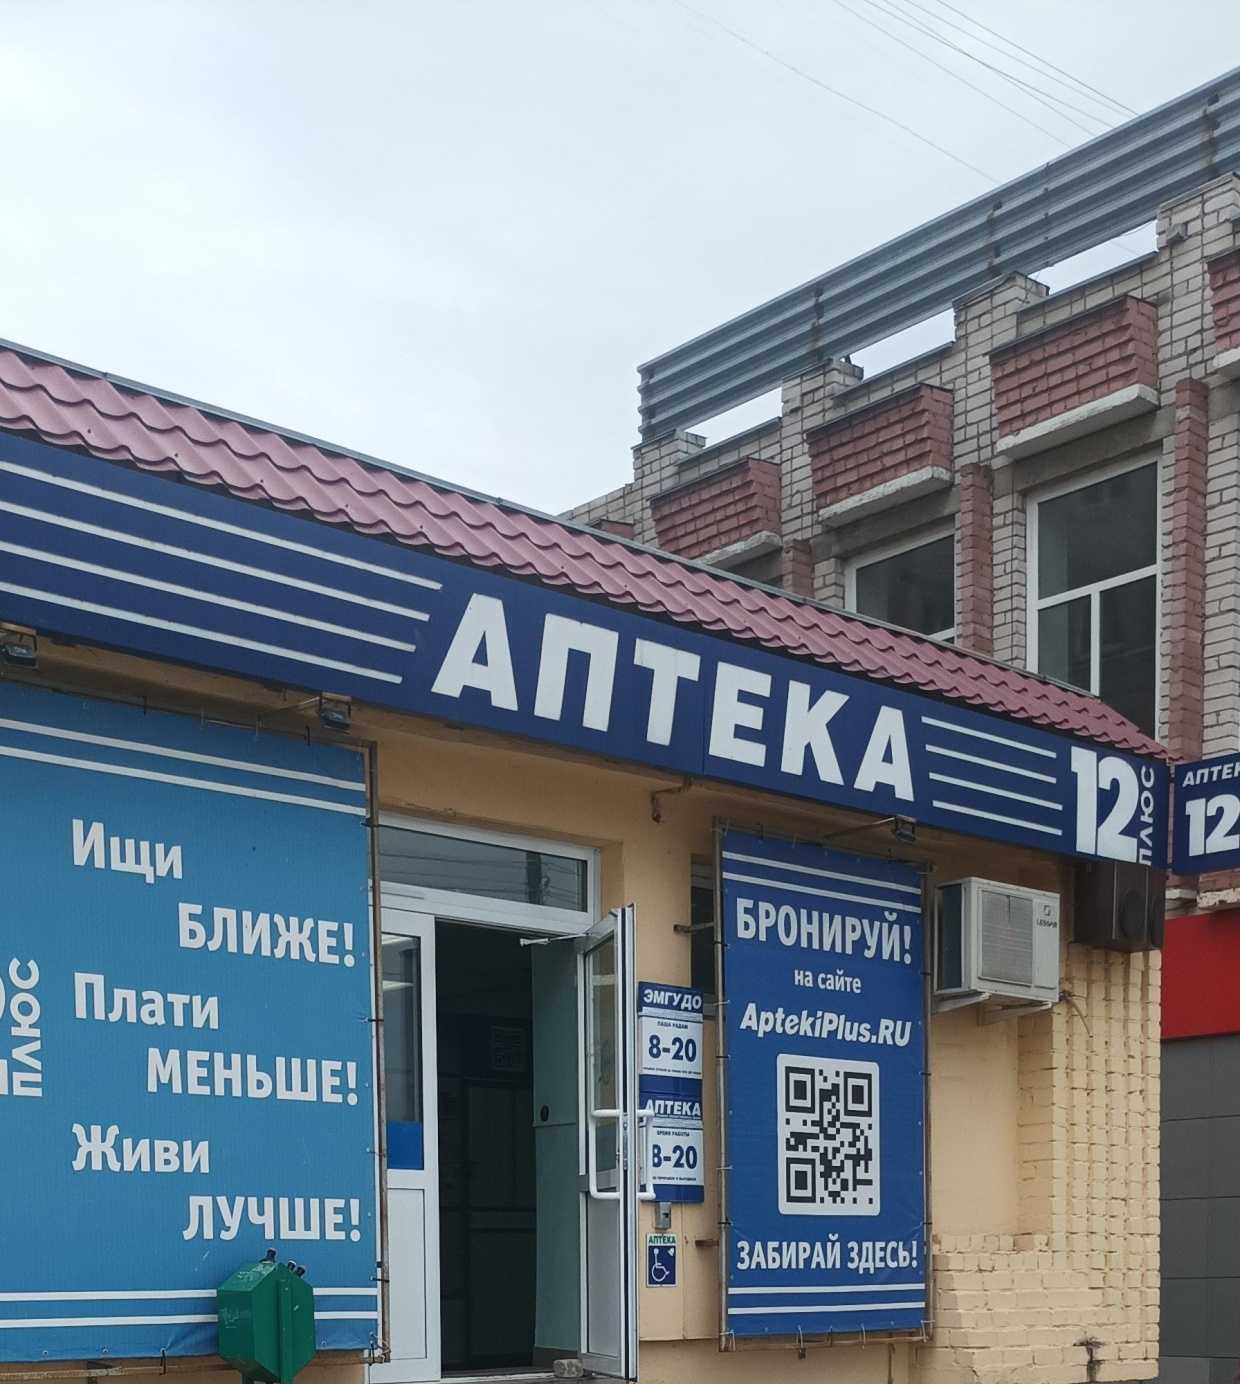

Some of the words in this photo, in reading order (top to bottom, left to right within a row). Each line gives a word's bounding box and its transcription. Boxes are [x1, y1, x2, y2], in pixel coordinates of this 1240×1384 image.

[431, 593, 915, 802] АПТЕКА
[1071, 746, 1139, 863] 12
[1139, 765, 1155, 866] ПЛЮС
[1185, 794, 1240, 857] 12
[72, 818, 183, 883] Ищи
[178, 902, 356, 967] БЛИЖЕ!
[735, 897, 913, 965] БРОНИРУЙ!
[74, 971, 220, 1031] Плати
[643, 989, 702, 1010] ЭМГУДО
[794, 969, 814, 989] на
[818, 969, 862, 994] сайте
[8, 957, 43, 1097] ПЛЮС
[648, 1034, 697, 1062] 8-20
[740, 1002, 912, 1047] AptekiPlus.RU
[147, 1047, 359, 1105] МЕНЬШЕ!
[645, 1099, 701, 1116] АПТЕКА
[71, 1123, 210, 1174] Живи
[183, 1195, 361, 1242] ЛУЧШЕ!
[648, 1235, 676, 1244] АПТЕКА
[736, 1234, 842, 1270] ЗАБИРАЙ
[847, 1240, 918, 1274] ЗДЕСЬ!
